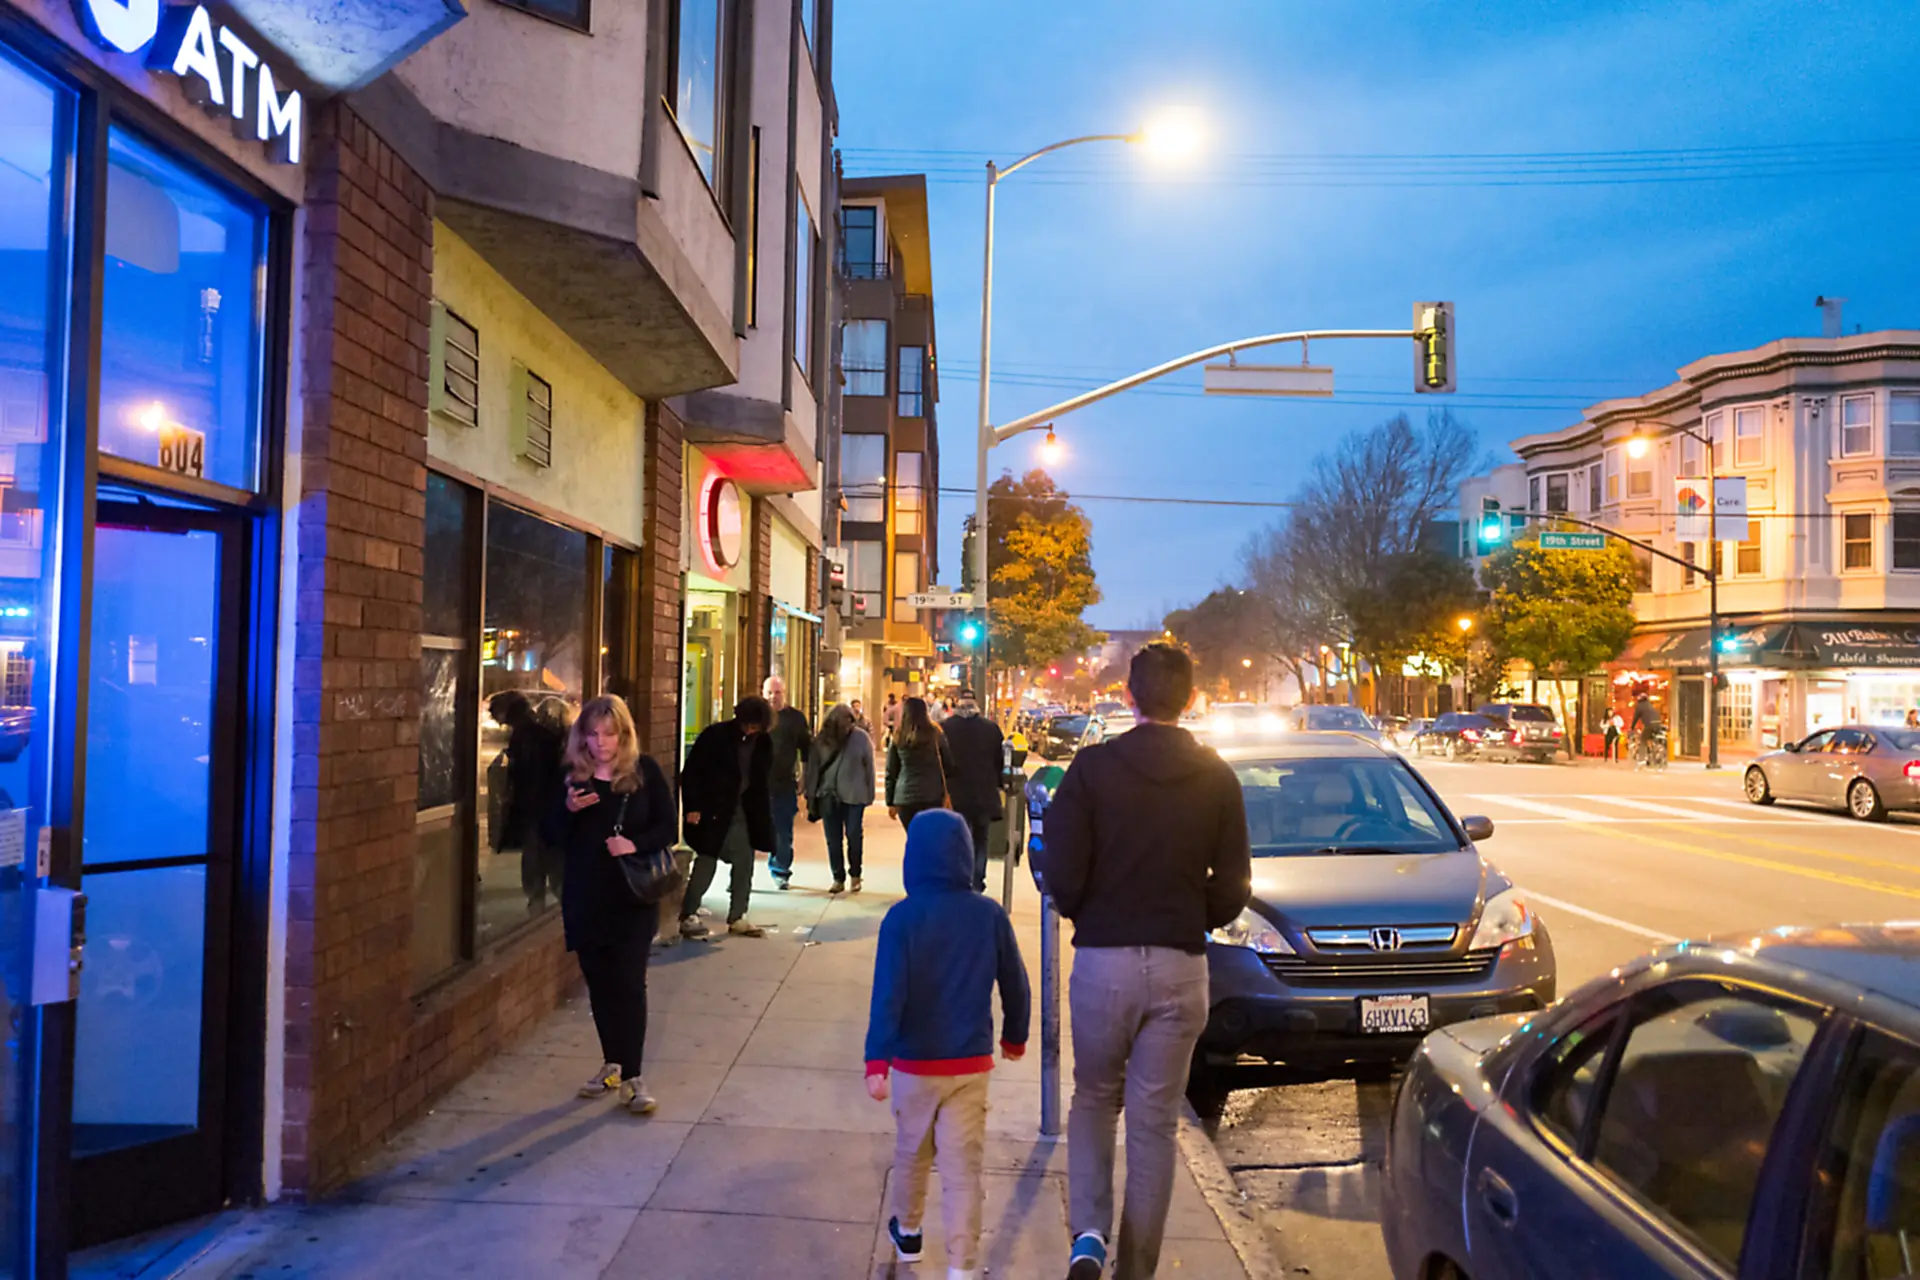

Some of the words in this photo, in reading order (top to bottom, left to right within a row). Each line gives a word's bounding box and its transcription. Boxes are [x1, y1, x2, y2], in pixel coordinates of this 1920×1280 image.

[172, 5, 301, 164] ATM
[1545, 536, 1566, 545] 19th
[1570, 536, 1600, 546] Street
[949, 596, 963, 605] ST
[1833, 652, 1867, 663] Falafel
[1366, 1008, 1426, 1027] 6HXV163
